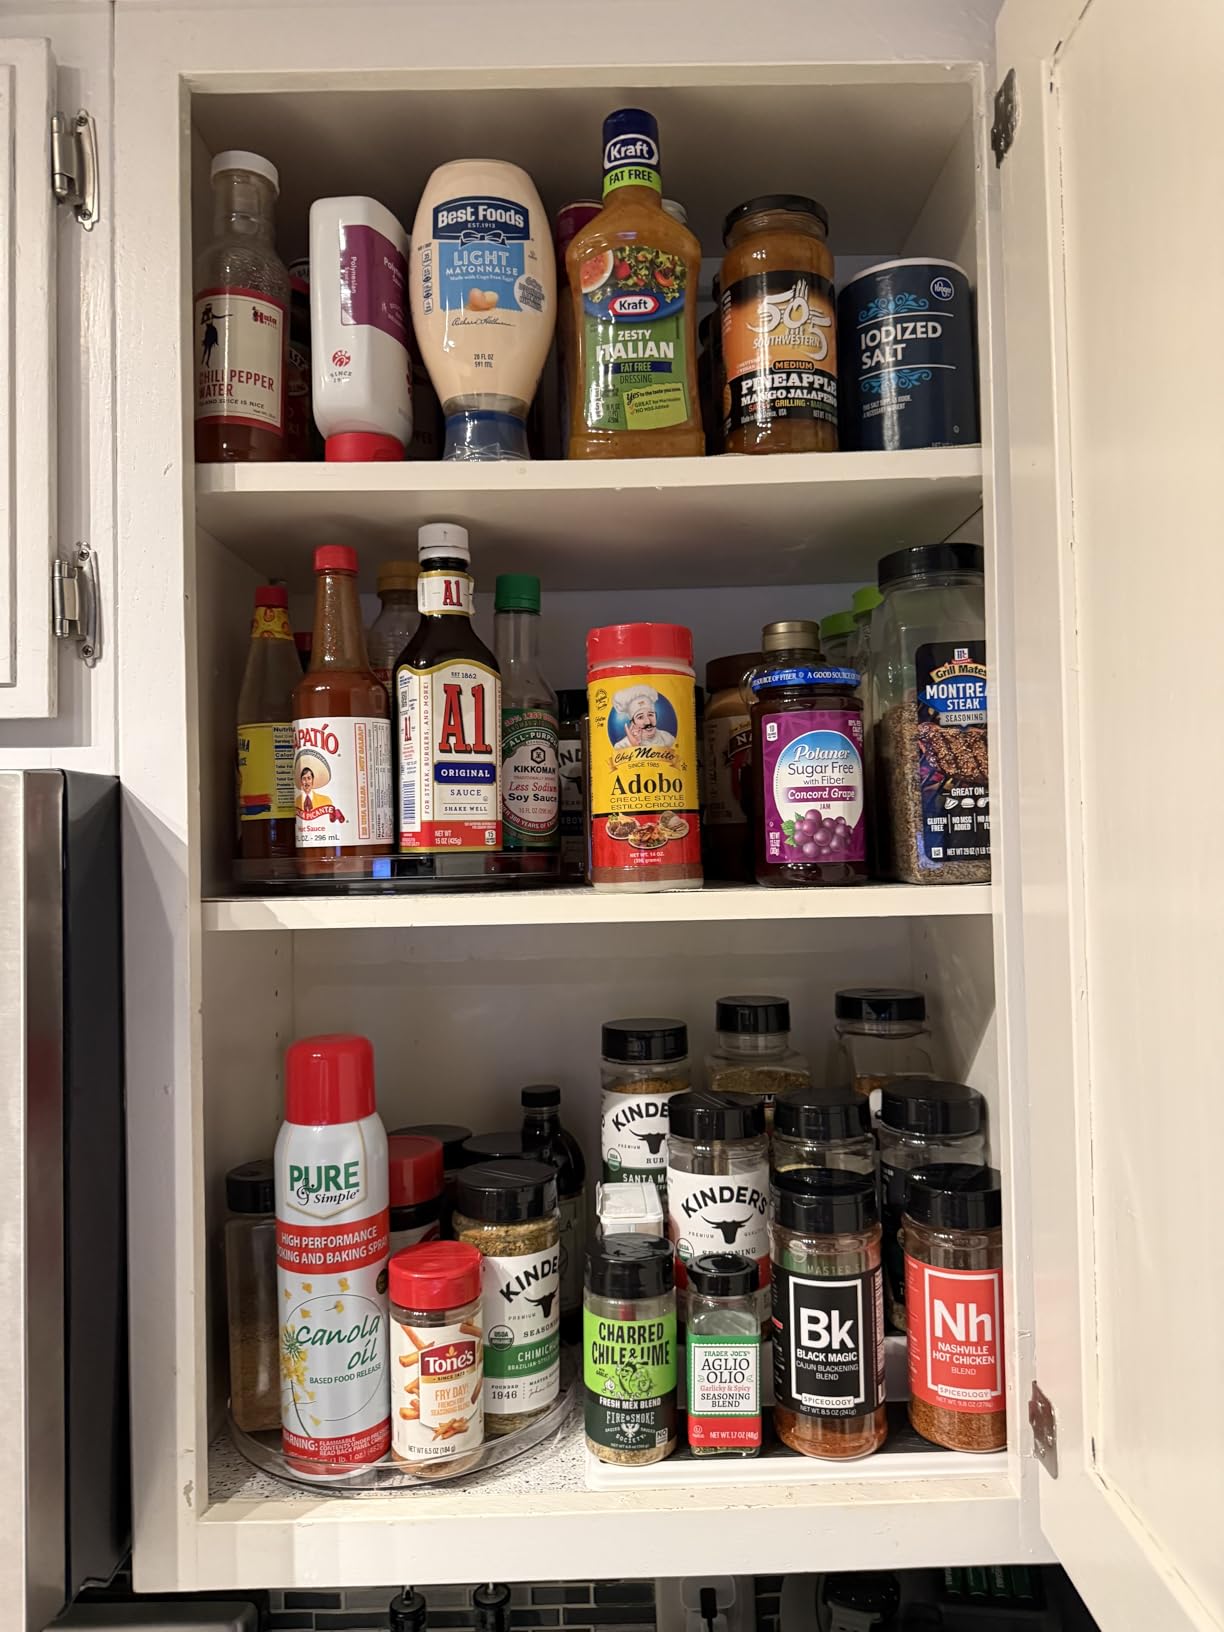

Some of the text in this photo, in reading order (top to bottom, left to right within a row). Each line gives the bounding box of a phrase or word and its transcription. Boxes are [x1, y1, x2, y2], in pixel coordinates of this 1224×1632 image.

[610, 142, 648, 160] Kraft
[609, 169, 653, 185] FAT FREE
[438, 205, 524, 228] Best Foods
[453, 251, 509, 266] LIGHT
[445, 265, 518, 276] MAYONNAISE
[619, 299, 648, 310] Kraft
[618, 330, 651, 340] ZESTY
[861, 322, 942, 350] IODIZED
[596, 341, 674, 361] ITALIAN
[862, 344, 906, 369] SALT
[620, 362, 652, 372] FAT FREE
[775, 361, 813, 370] MEDIUM
[230, 369, 274, 392] PEPPER
[620, 374, 652, 384] DRESSING
[626, 392, 639, 405] Yes
[776, 399, 805, 408] GRILLING
[936, 664, 987, 678] Grill Mates
[947, 698, 980, 710] STEAK
[945, 714, 983, 722] SEASONING
[615, 747, 675, 763] Chef Merito
[794, 744, 850, 762] Polaner
[441, 768, 490, 777] ORIGINAL
[514, 765, 556, 775] KIKKOMAN
[788, 762, 854, 778] Sugar Free
[610, 773, 683, 795] Adobo
[821, 776, 845, 784] Fiber
[509, 782, 529, 792] Less
[951, 787, 984, 796] GREAT ON
[508, 793, 530, 803] Soy
[788, 788, 855, 800] Concord Grape
[306, 806, 334, 819] PICANTE
[927, 817, 947, 825] GLUTEN
[954, 823, 971, 831] ADDED
[612, 1102, 669, 1132] KINDE
[289, 1160, 359, 1193] PURE
[622, 1174, 653, 1183] SANTA
[314, 1191, 356, 1205] Simple
[681, 1186, 768, 1219] KINDER'S
[282, 1226, 377, 1249] HIGH PERFORMANCE
[688, 1231, 714, 1239] PREMIUM
[301, 1246, 367, 1264] AND BAKING
[500, 1256, 559, 1303] KINDE
[508, 1312, 536, 1321] PREMIUM
[934, 1299, 993, 1342] Nh
[599, 1322, 664, 1345] CHARRED
[800, 1308, 855, 1350] Bk
[347, 1338, 377, 1370] oil
[592, 1341, 625, 1365] CHILE
[629, 1348, 637, 1359] &
[938, 1342, 989, 1354] NASHVILLE
[424, 1350, 473, 1373] Tone's
[797, 1349, 857, 1362] BLACK MAGIC
[932, 1351, 995, 1365] HOT CHICKEN
[701, 1358, 750, 1371] AGLIO
[796, 1360, 859, 1372] CAJUN BLACKENING
[951, 1367, 976, 1375] BLEND
[310, 1363, 382, 1384] BASED FOOD RELEASE
[706, 1371, 745, 1383] OLIO
[435, 1389, 451, 1401] FRY
[492, 1391, 517, 1399] 1946
[940, 1387, 989, 1397] SPICEOLOGY
[600, 1397, 661, 1409] FRESH MEX BLEND
[804, 1396, 852, 1406] SPICEOLOGY
[606, 1411, 655, 1424] FIRE SMOKE
[616, 1434, 645, 1443] SOCIETY
[657, 1430, 667, 1438] NO
